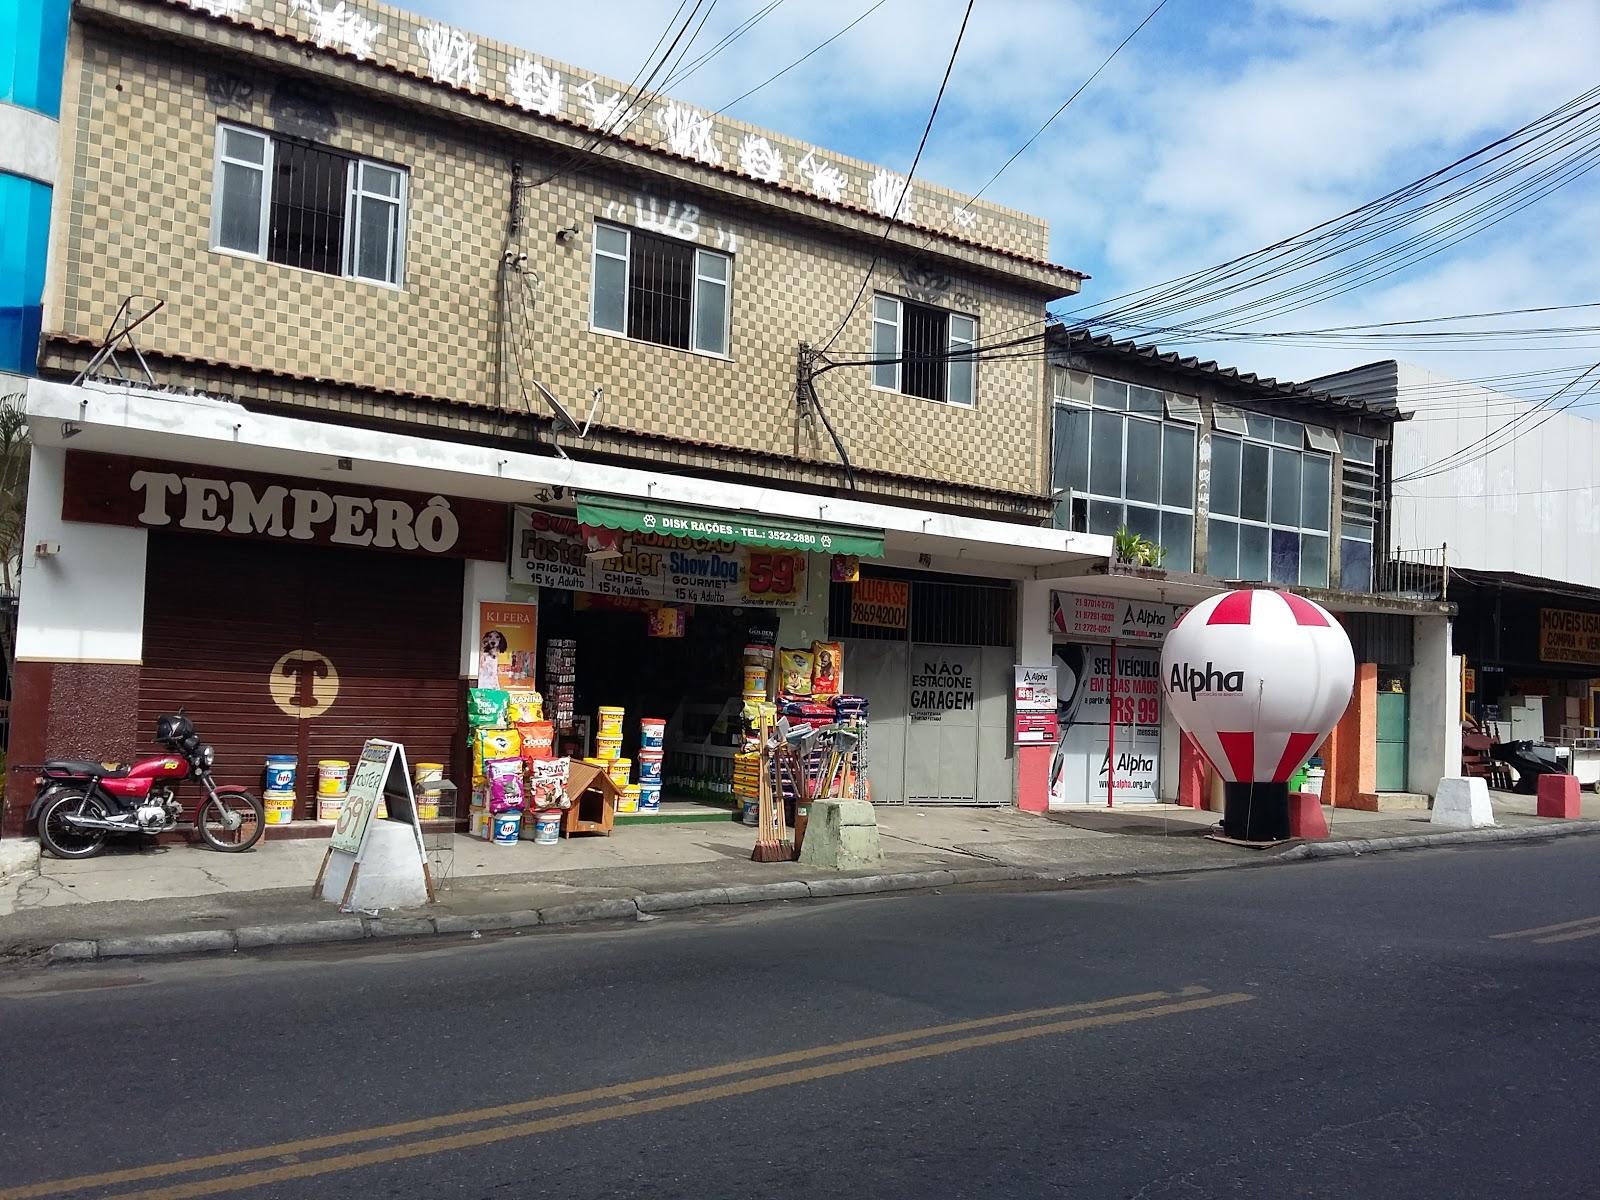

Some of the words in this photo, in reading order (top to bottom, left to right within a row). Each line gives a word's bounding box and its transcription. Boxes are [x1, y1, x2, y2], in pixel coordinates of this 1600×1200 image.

[130, 470, 459, 553] TEMPERÔ
[661, 517, 689, 531] DISK
[690, 521, 733, 536] RAÇÕES
[740, 527, 766, 541] TEL.:
[767, 530, 816, 545] 3522-2880
[526, 561, 586, 577] ORIGINAL
[530, 573, 543, 585] 15
[545, 575, 555, 588] Kg
[557, 577, 585, 590] Adulto
[604, 573, 643, 586] CHIPS
[672, 576, 728, 590] GOURMET
[597, 582, 611, 594] 15
[624, 586, 650, 598] Adulto
[675, 588, 686, 601] 15
[687, 591, 698, 602] Kg
[700, 591, 726, 604] Adulto
[1075, 598, 1082, 606] 21
[503, 612, 530, 624] FERA
[1075, 610, 1082, 619] 21
[1136, 609, 1166, 628] Alpha
[1074, 622, 1081, 631] 21
[924, 662, 963, 676] NÃO
[1117, 656, 1160, 678] VEÍCULO
[282, 658, 328, 708] T
[912, 675, 972, 689] ESTACIONE
[1090, 677, 1104, 692] EM
[1170, 661, 1244, 701] Alpha
[911, 690, 974, 710] GARAGEM
[1138, 698, 1159, 724] 99
[1117, 753, 1153, 776] Alpha
[277, 772, 291, 783] hth
[1099, 779, 1152, 790] ww.alpha.org.br
